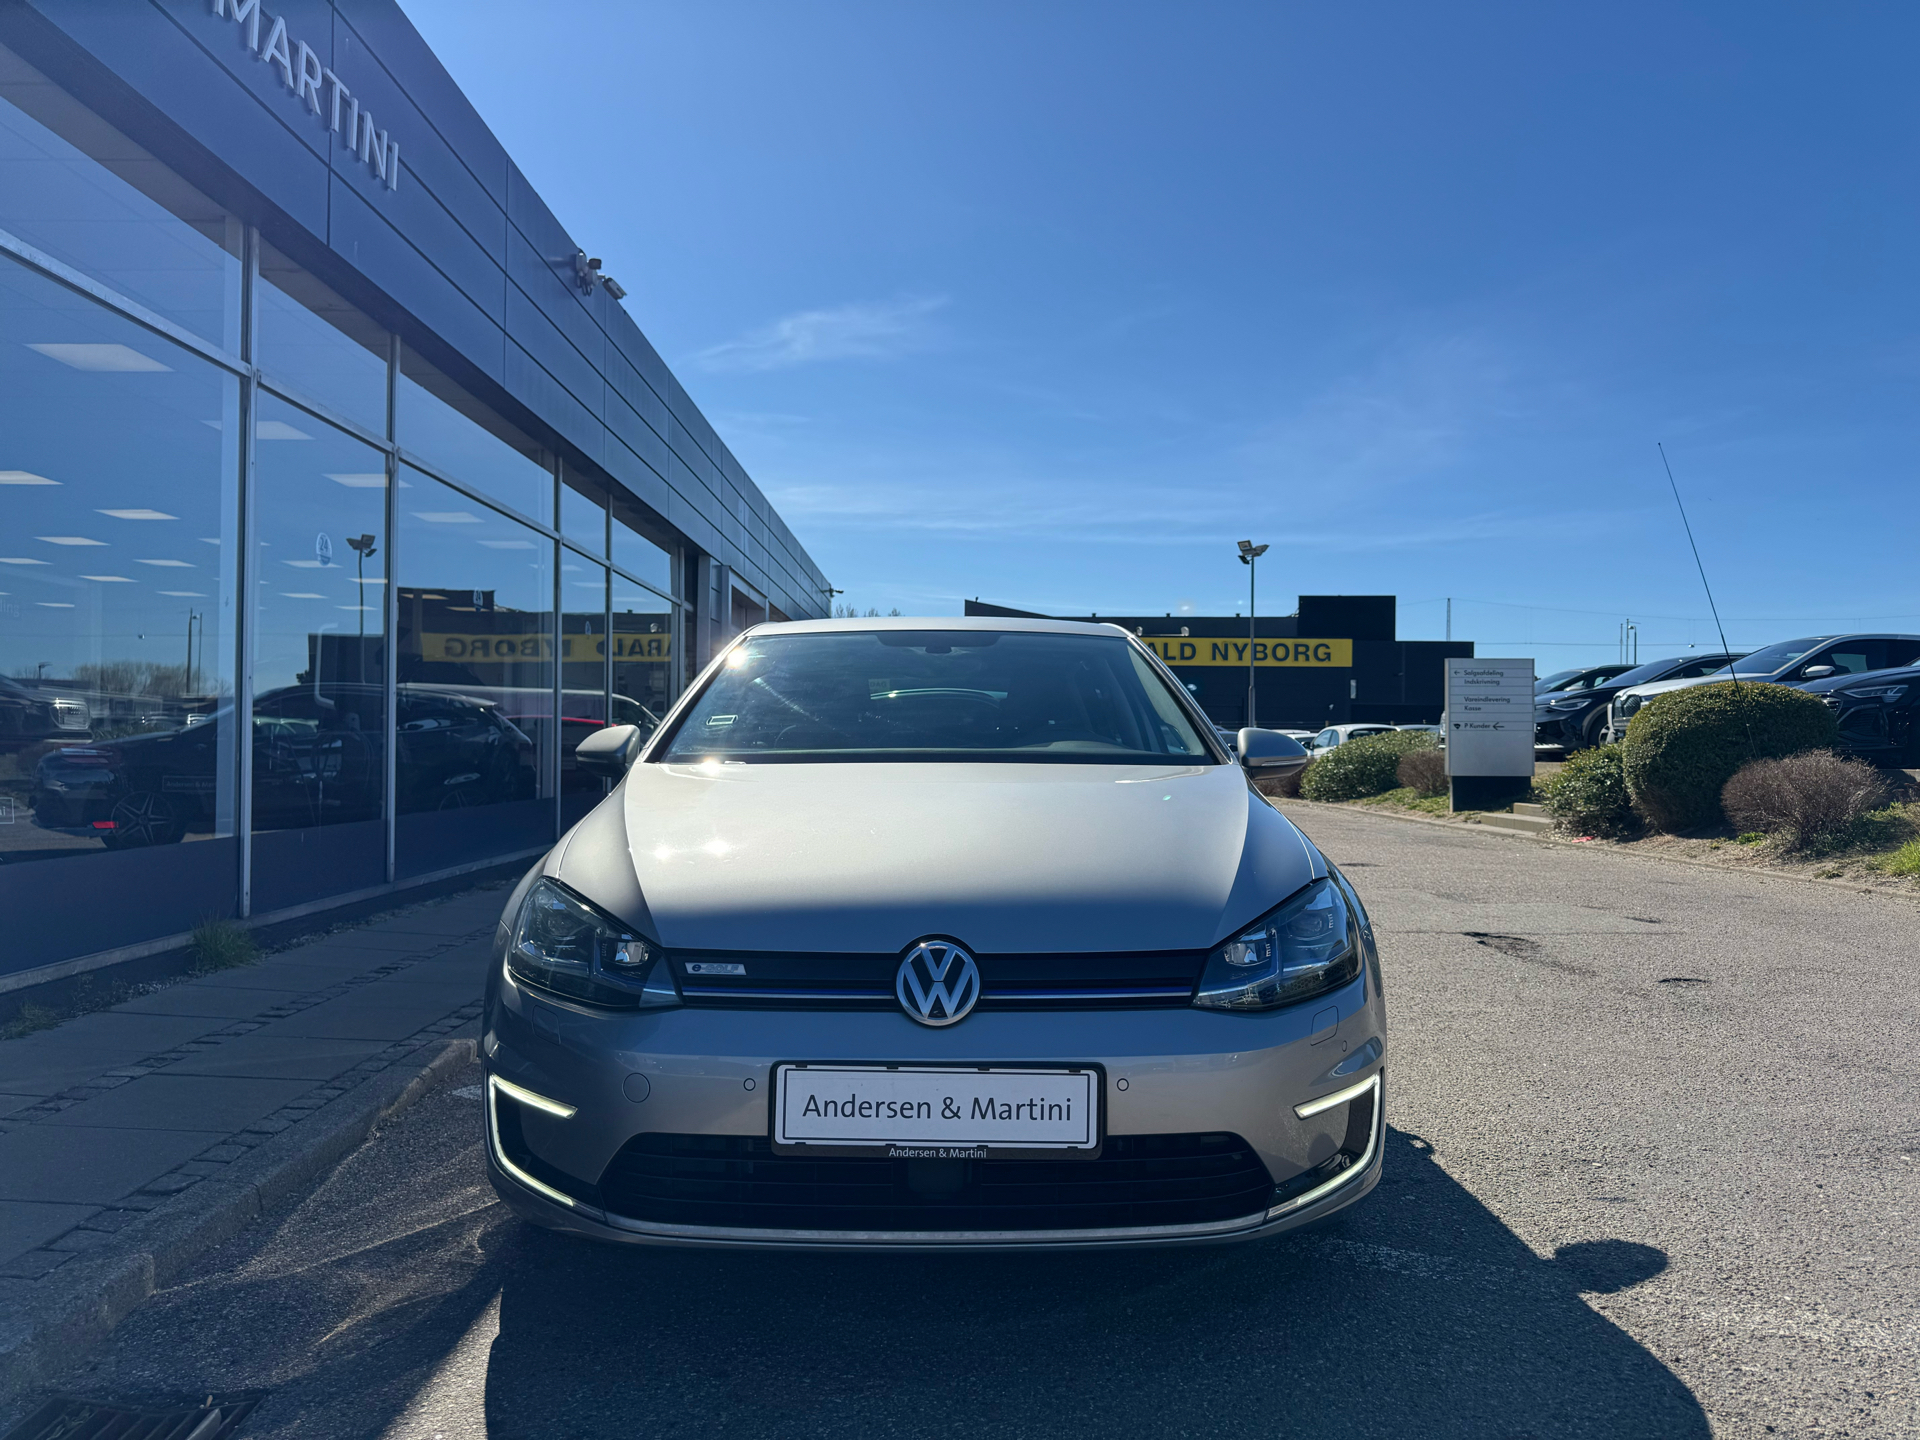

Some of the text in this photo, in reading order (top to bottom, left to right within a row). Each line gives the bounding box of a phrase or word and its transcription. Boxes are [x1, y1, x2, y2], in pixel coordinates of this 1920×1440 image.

[1211, 642, 1332, 662] NYBORG
[802, 1093, 1071, 1121] Andersen & Martini
[888, 1147, 986, 1158] Andersen & Martini
